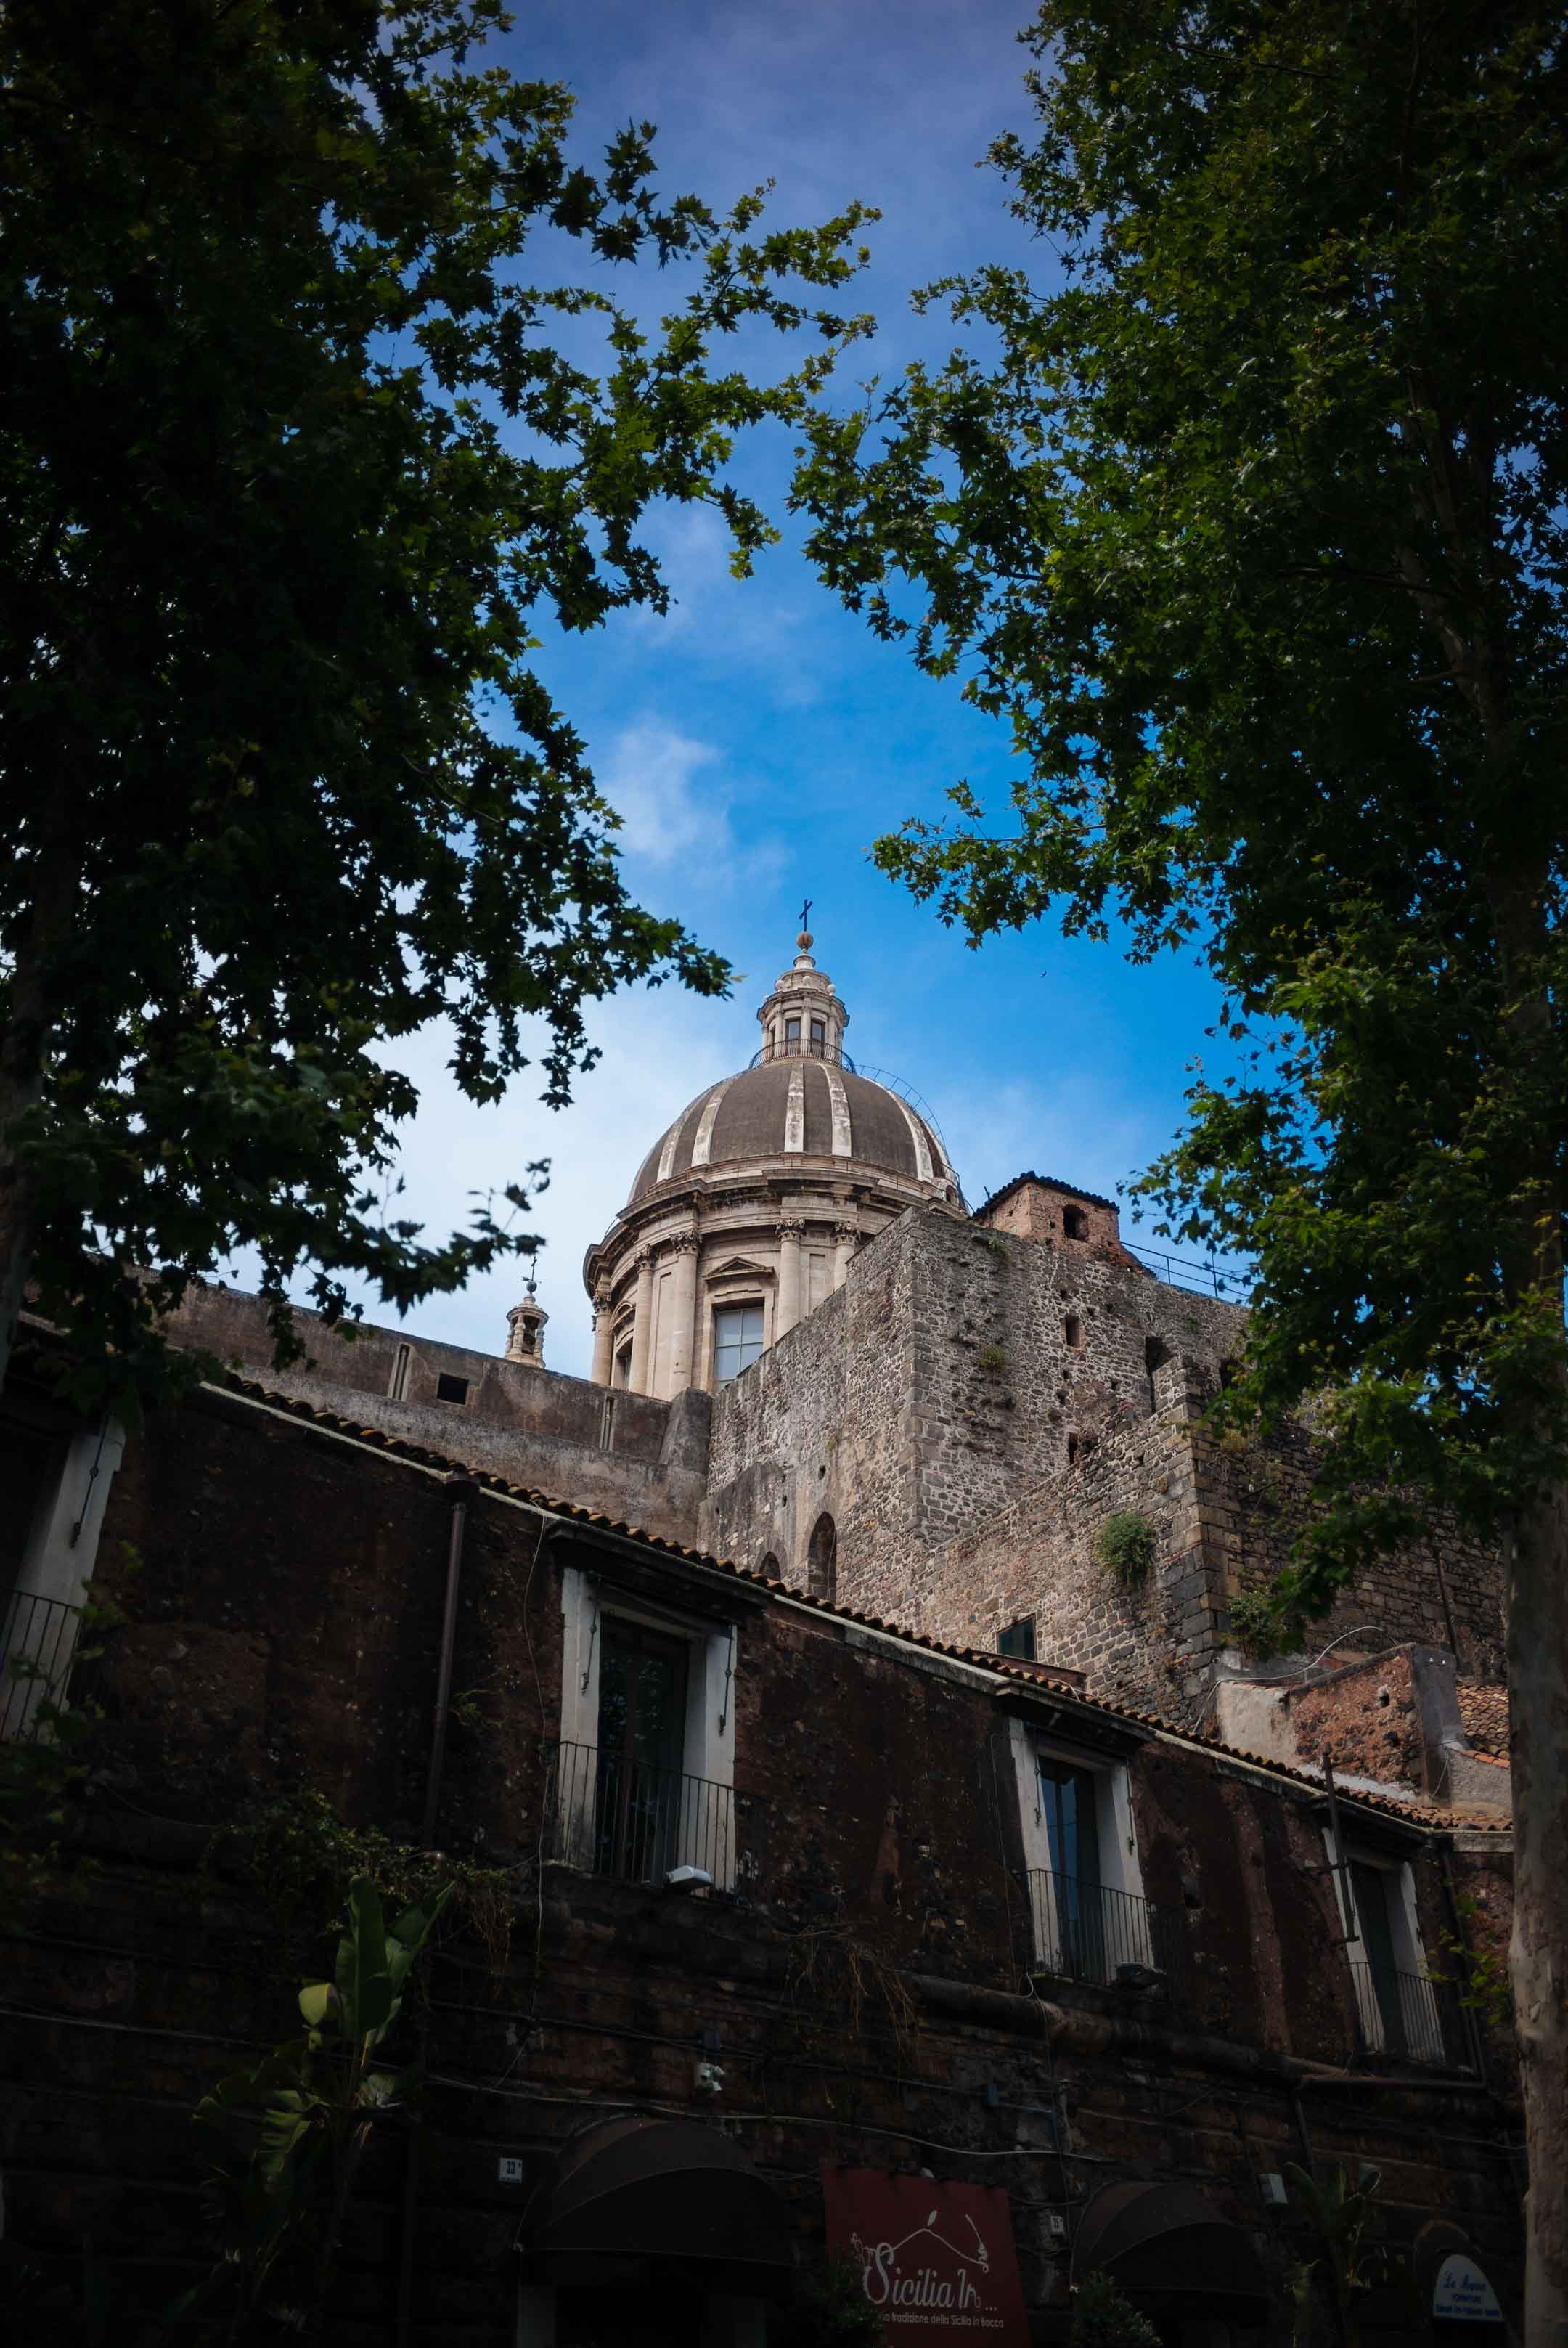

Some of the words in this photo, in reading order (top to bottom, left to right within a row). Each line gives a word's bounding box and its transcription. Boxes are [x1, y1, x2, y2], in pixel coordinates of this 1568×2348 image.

[862, 2242, 955, 2307] Sicilia
[891, 2311, 929, 2324] tradizione
[931, 2312, 950, 2325] della
[951, 2314, 972, 2327] Sicilia
